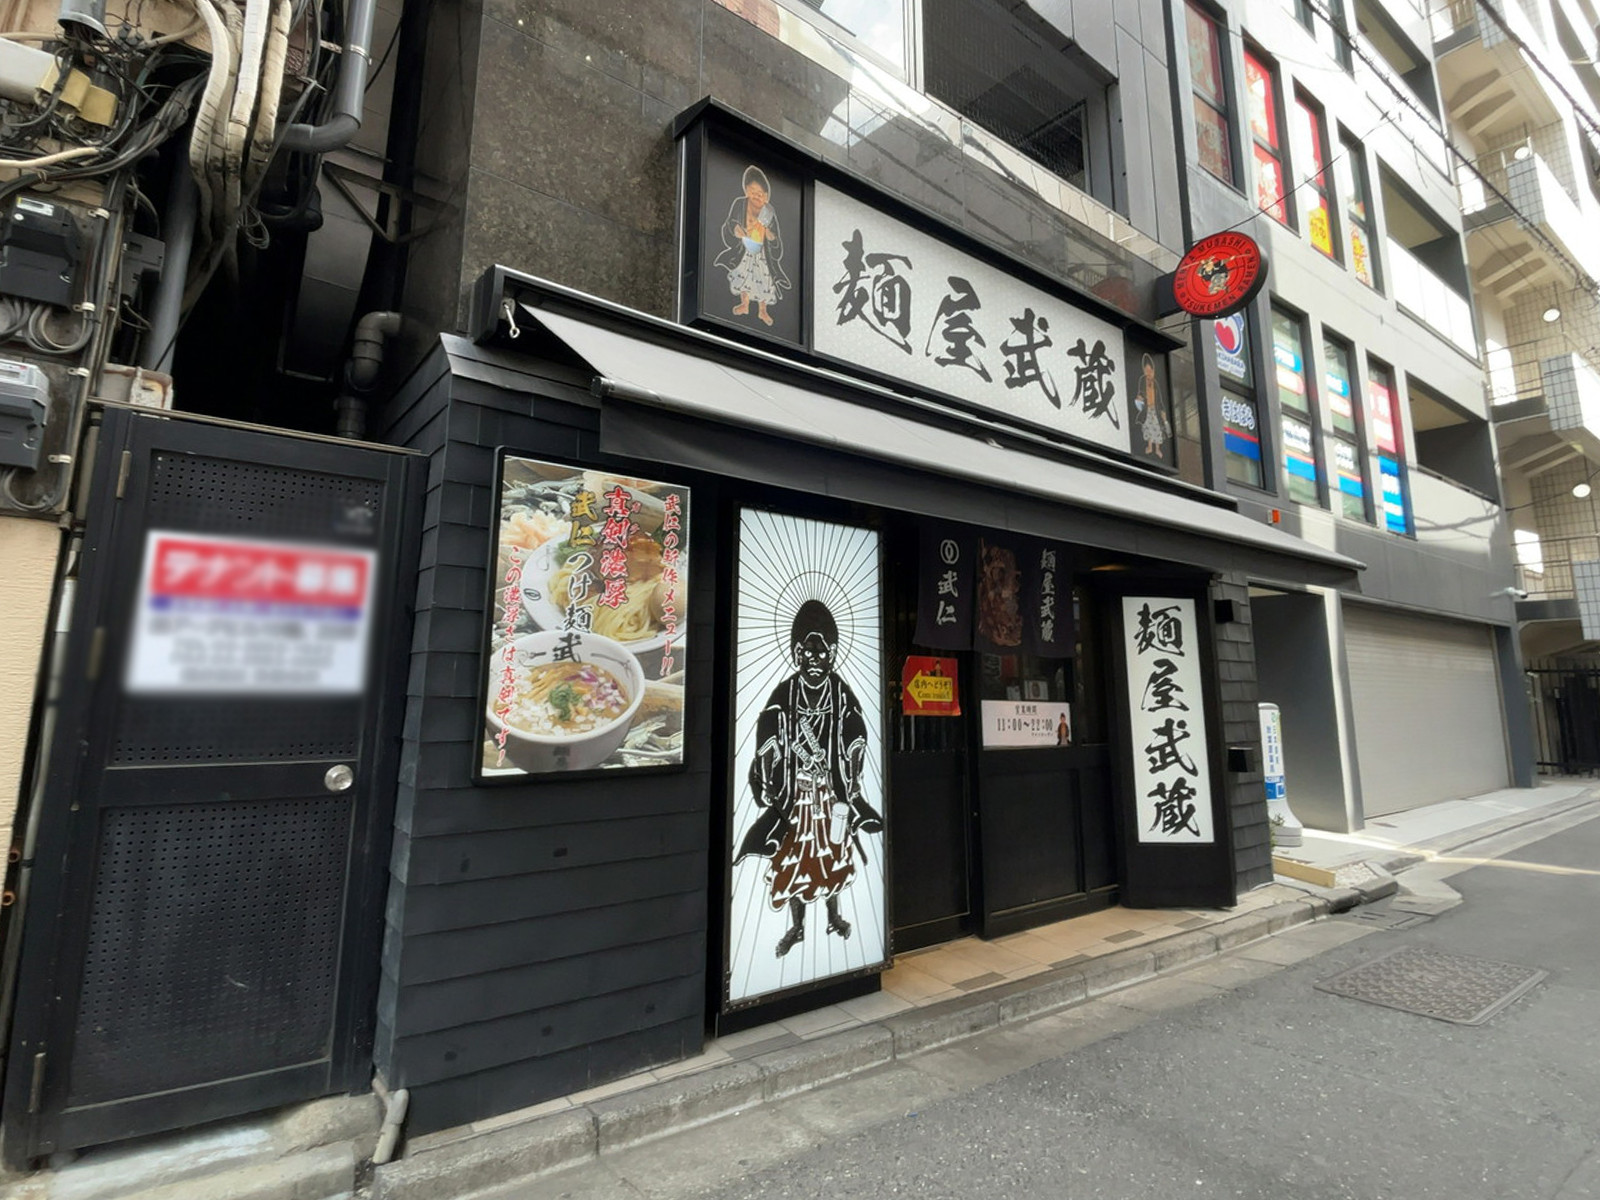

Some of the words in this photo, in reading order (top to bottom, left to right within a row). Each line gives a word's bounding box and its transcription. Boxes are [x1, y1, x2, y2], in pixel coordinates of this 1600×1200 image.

[1198, 237, 1246, 252] MUSASHI
[833, 229, 1120, 430] 麺屋武蔵
[1184, 294, 1236, 312] TSUKEMEN
[936, 571, 958, 625] 武仁
[1040, 548, 1056, 642] 麺屋武蔵
[1133, 602, 1201, 837] 麺屋武蔵
